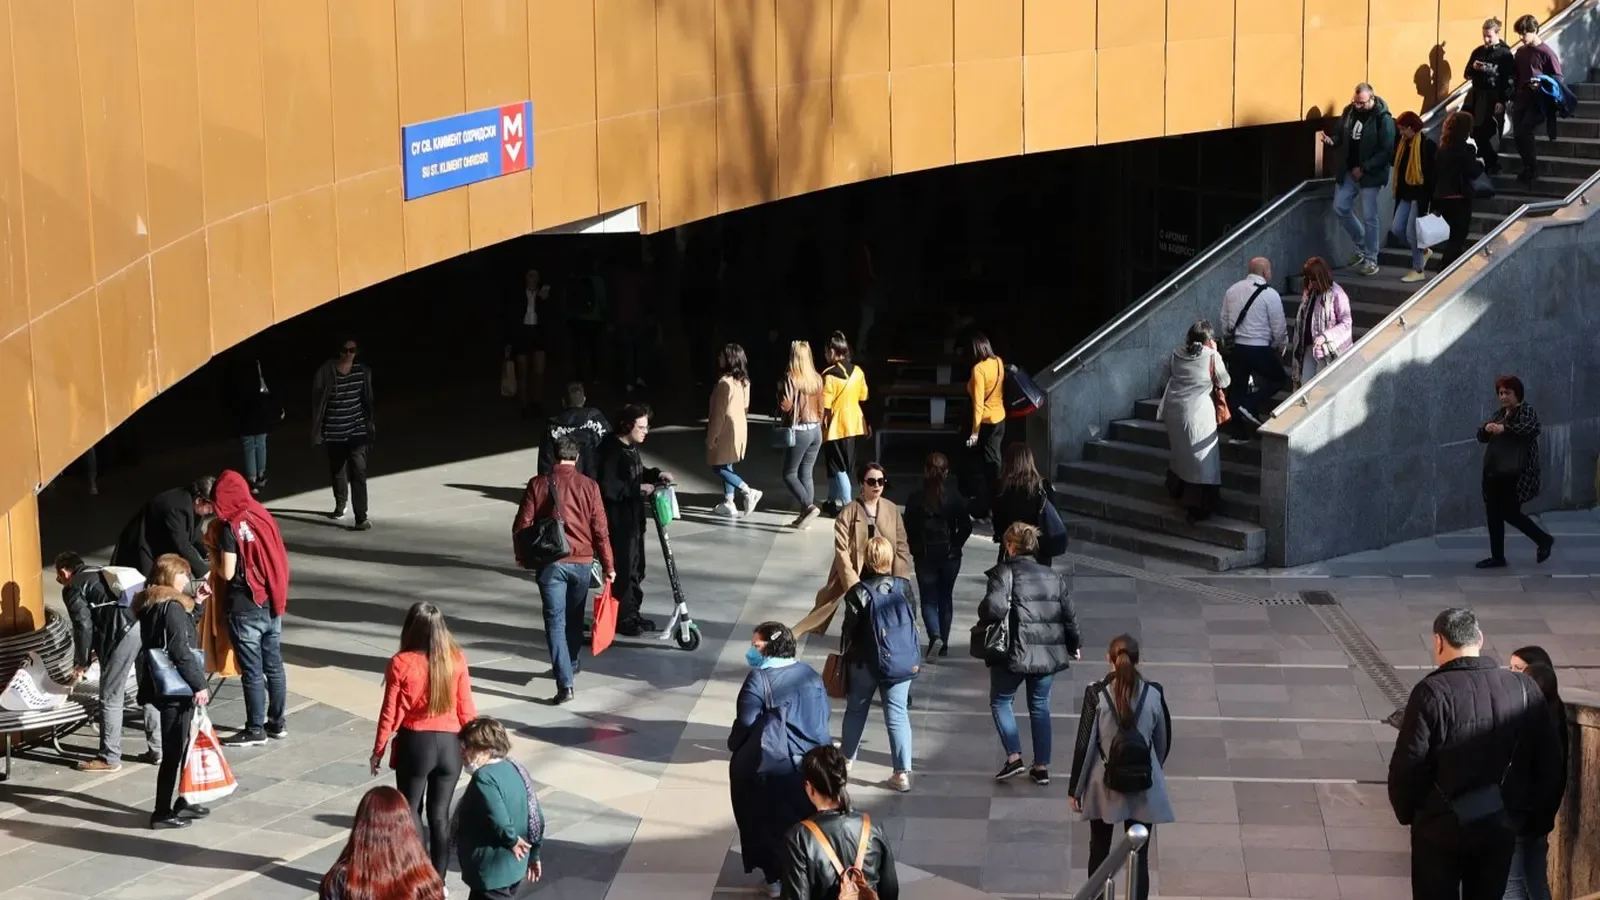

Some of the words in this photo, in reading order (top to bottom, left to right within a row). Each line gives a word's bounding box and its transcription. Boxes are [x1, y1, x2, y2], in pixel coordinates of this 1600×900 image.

[411, 141, 421, 156] СУ
[433, 131, 462, 150] КЛИМЕНТ
[462, 124, 497, 143] ОХРИДСКИ
[422, 165, 431, 178] SU
[439, 156, 463, 174] KLIMENT
[463, 151, 489, 168] OHRIDSKI
